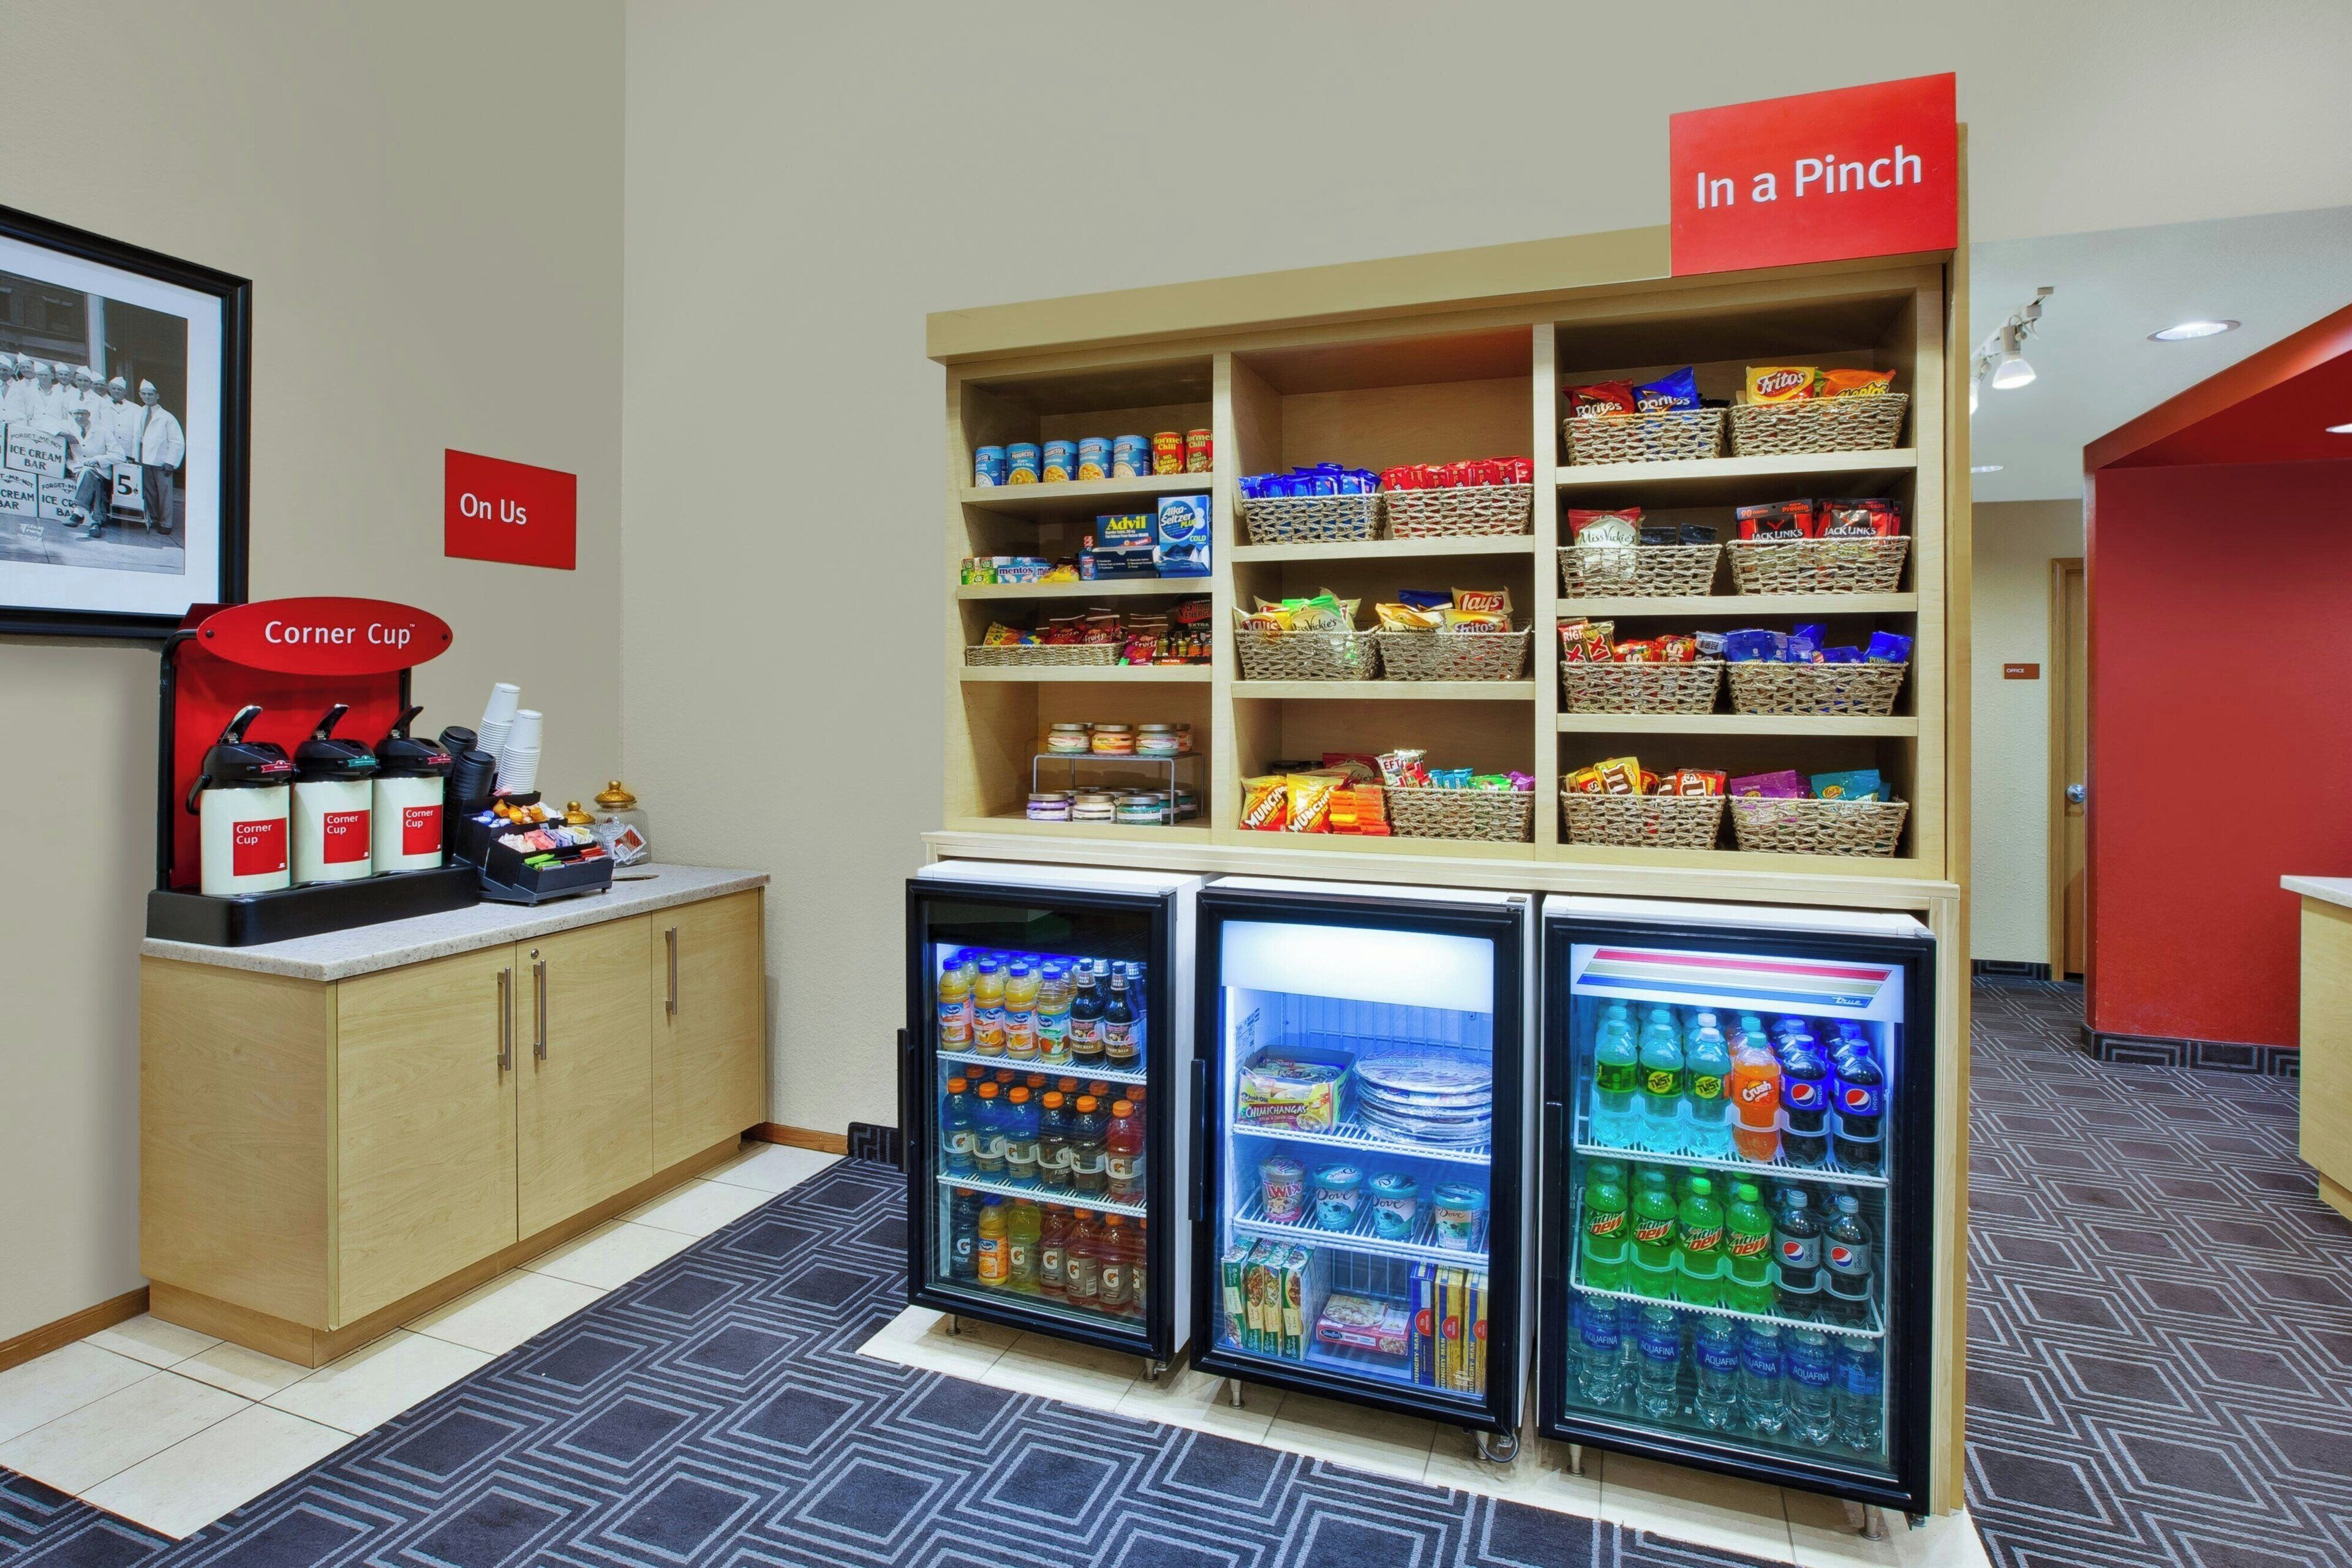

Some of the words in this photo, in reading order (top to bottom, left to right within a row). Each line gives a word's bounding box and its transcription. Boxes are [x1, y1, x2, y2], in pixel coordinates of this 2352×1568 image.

[1698, 172, 1734, 209] In
[1752, 172, 1777, 203] a
[1795, 145, 1922, 198] Pinch
[1756, 371, 1805, 395] Fritos
[1575, 401, 1623, 418] Doritos
[1637, 396, 1691, 413] Doritos
[10, 445, 26, 456] ICE
[29, 448, 62, 463] CREAM
[24, 458, 47, 470] BAR
[42, 494, 58, 505] ICE
[460, 492, 492, 520] On
[500, 499, 527, 525] Us
[1164, 506, 1187, 516] Alka-
[1106, 516, 1146, 530] Advil
[1161, 512, 1193, 526] Seltzer
[1774, 529, 1803, 538] LINK'S
[1823, 527, 1847, 537] JACK
[1848, 526, 1876, 536] LINK'S
[999, 567, 1033, 575] mentos
[265, 620, 356, 644] Corner
[327, 814, 359, 824] Corner
[405, 809, 434, 818] Corner
[236, 823, 272, 834] Corner
[327, 825, 347, 835] Cup
[405, 819, 423, 829] Cup
[236, 835, 258, 845] Cup
[1743, 1080, 1771, 1102] Crush
[1246, 1106, 1308, 1118] CHIMICHANGAS
[1317, 1186, 1354, 1201] Dove
[1011, 1246, 1025, 1265] G
[1042, 1251, 1058, 1270] G
[1067, 1259, 1080, 1280] G
[1103, 1268, 1119, 1287] G
[1585, 1330, 1618, 1345] AQUAFINA
[1641, 1340, 1675, 1356] AQUAFINA
[1705, 1353, 1738, 1366] AQUAFINA
[1793, 1365, 1830, 1381] AQUAFINA
